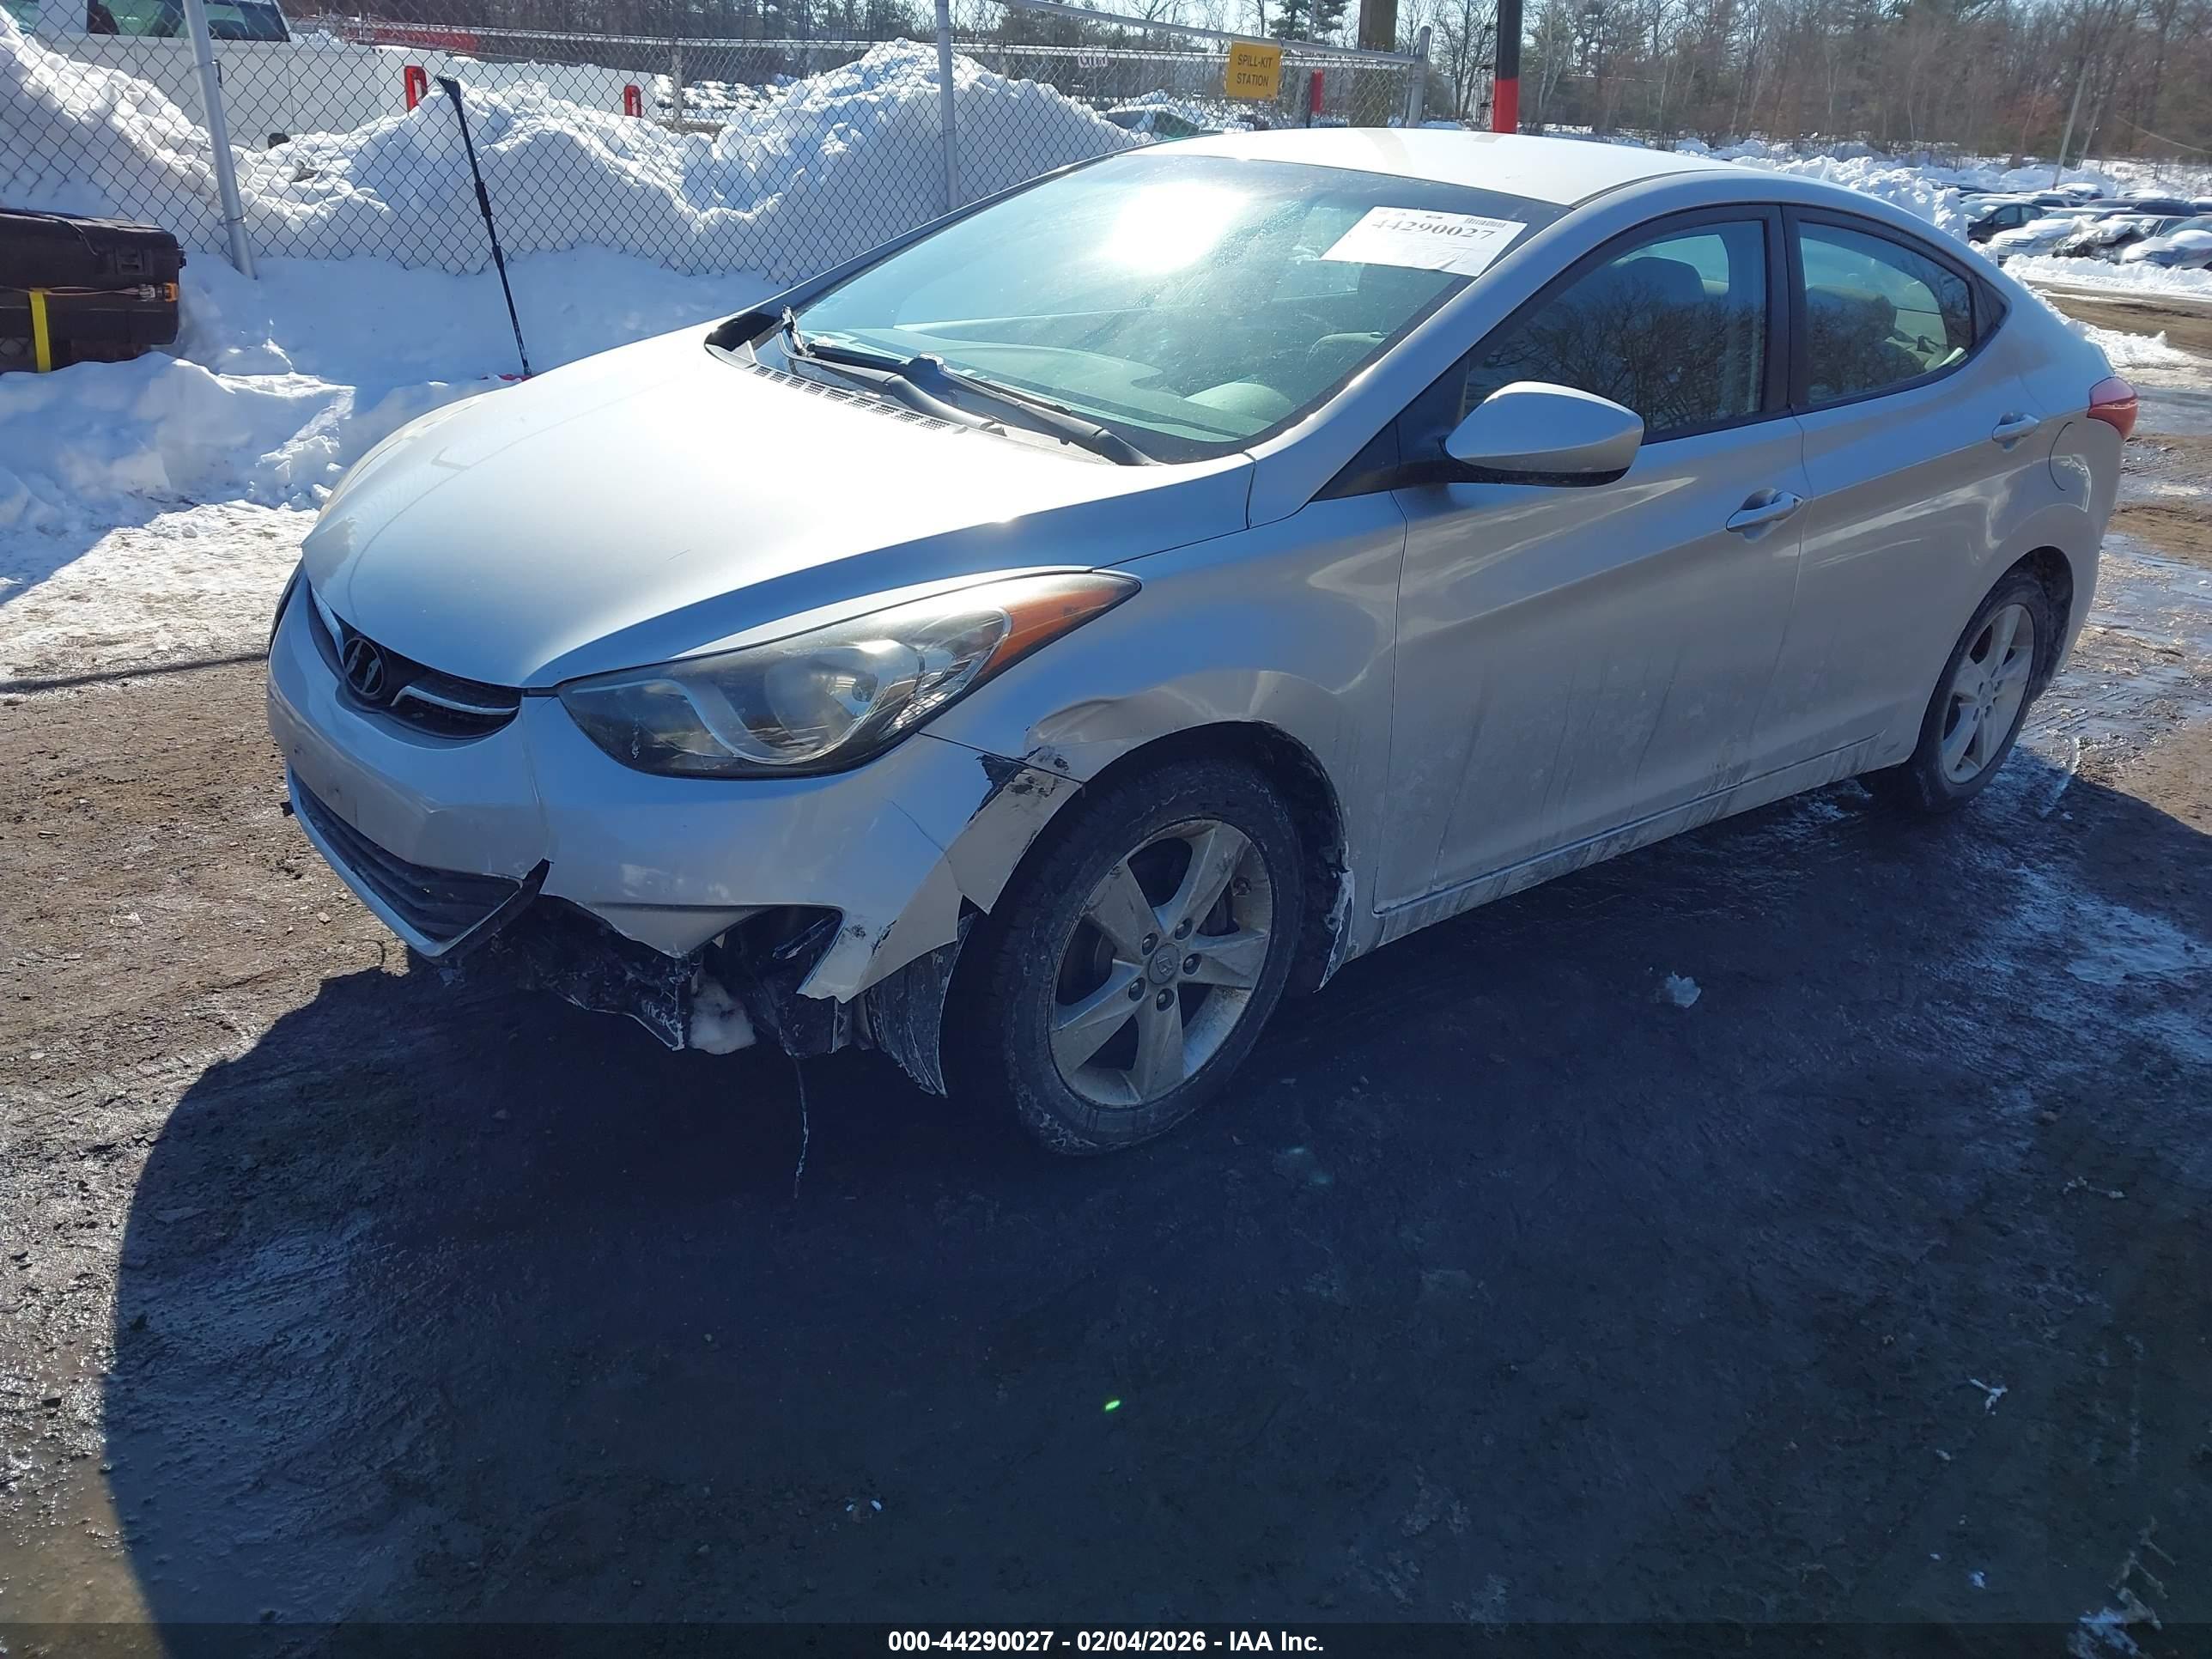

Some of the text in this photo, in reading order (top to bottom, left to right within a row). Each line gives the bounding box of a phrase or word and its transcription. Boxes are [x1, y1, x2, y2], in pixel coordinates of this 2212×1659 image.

[1237, 53, 1273, 69] SPILL-KIT
[1237, 72, 1269, 88] STATION
[1371, 219, 1497, 240] 44290027
